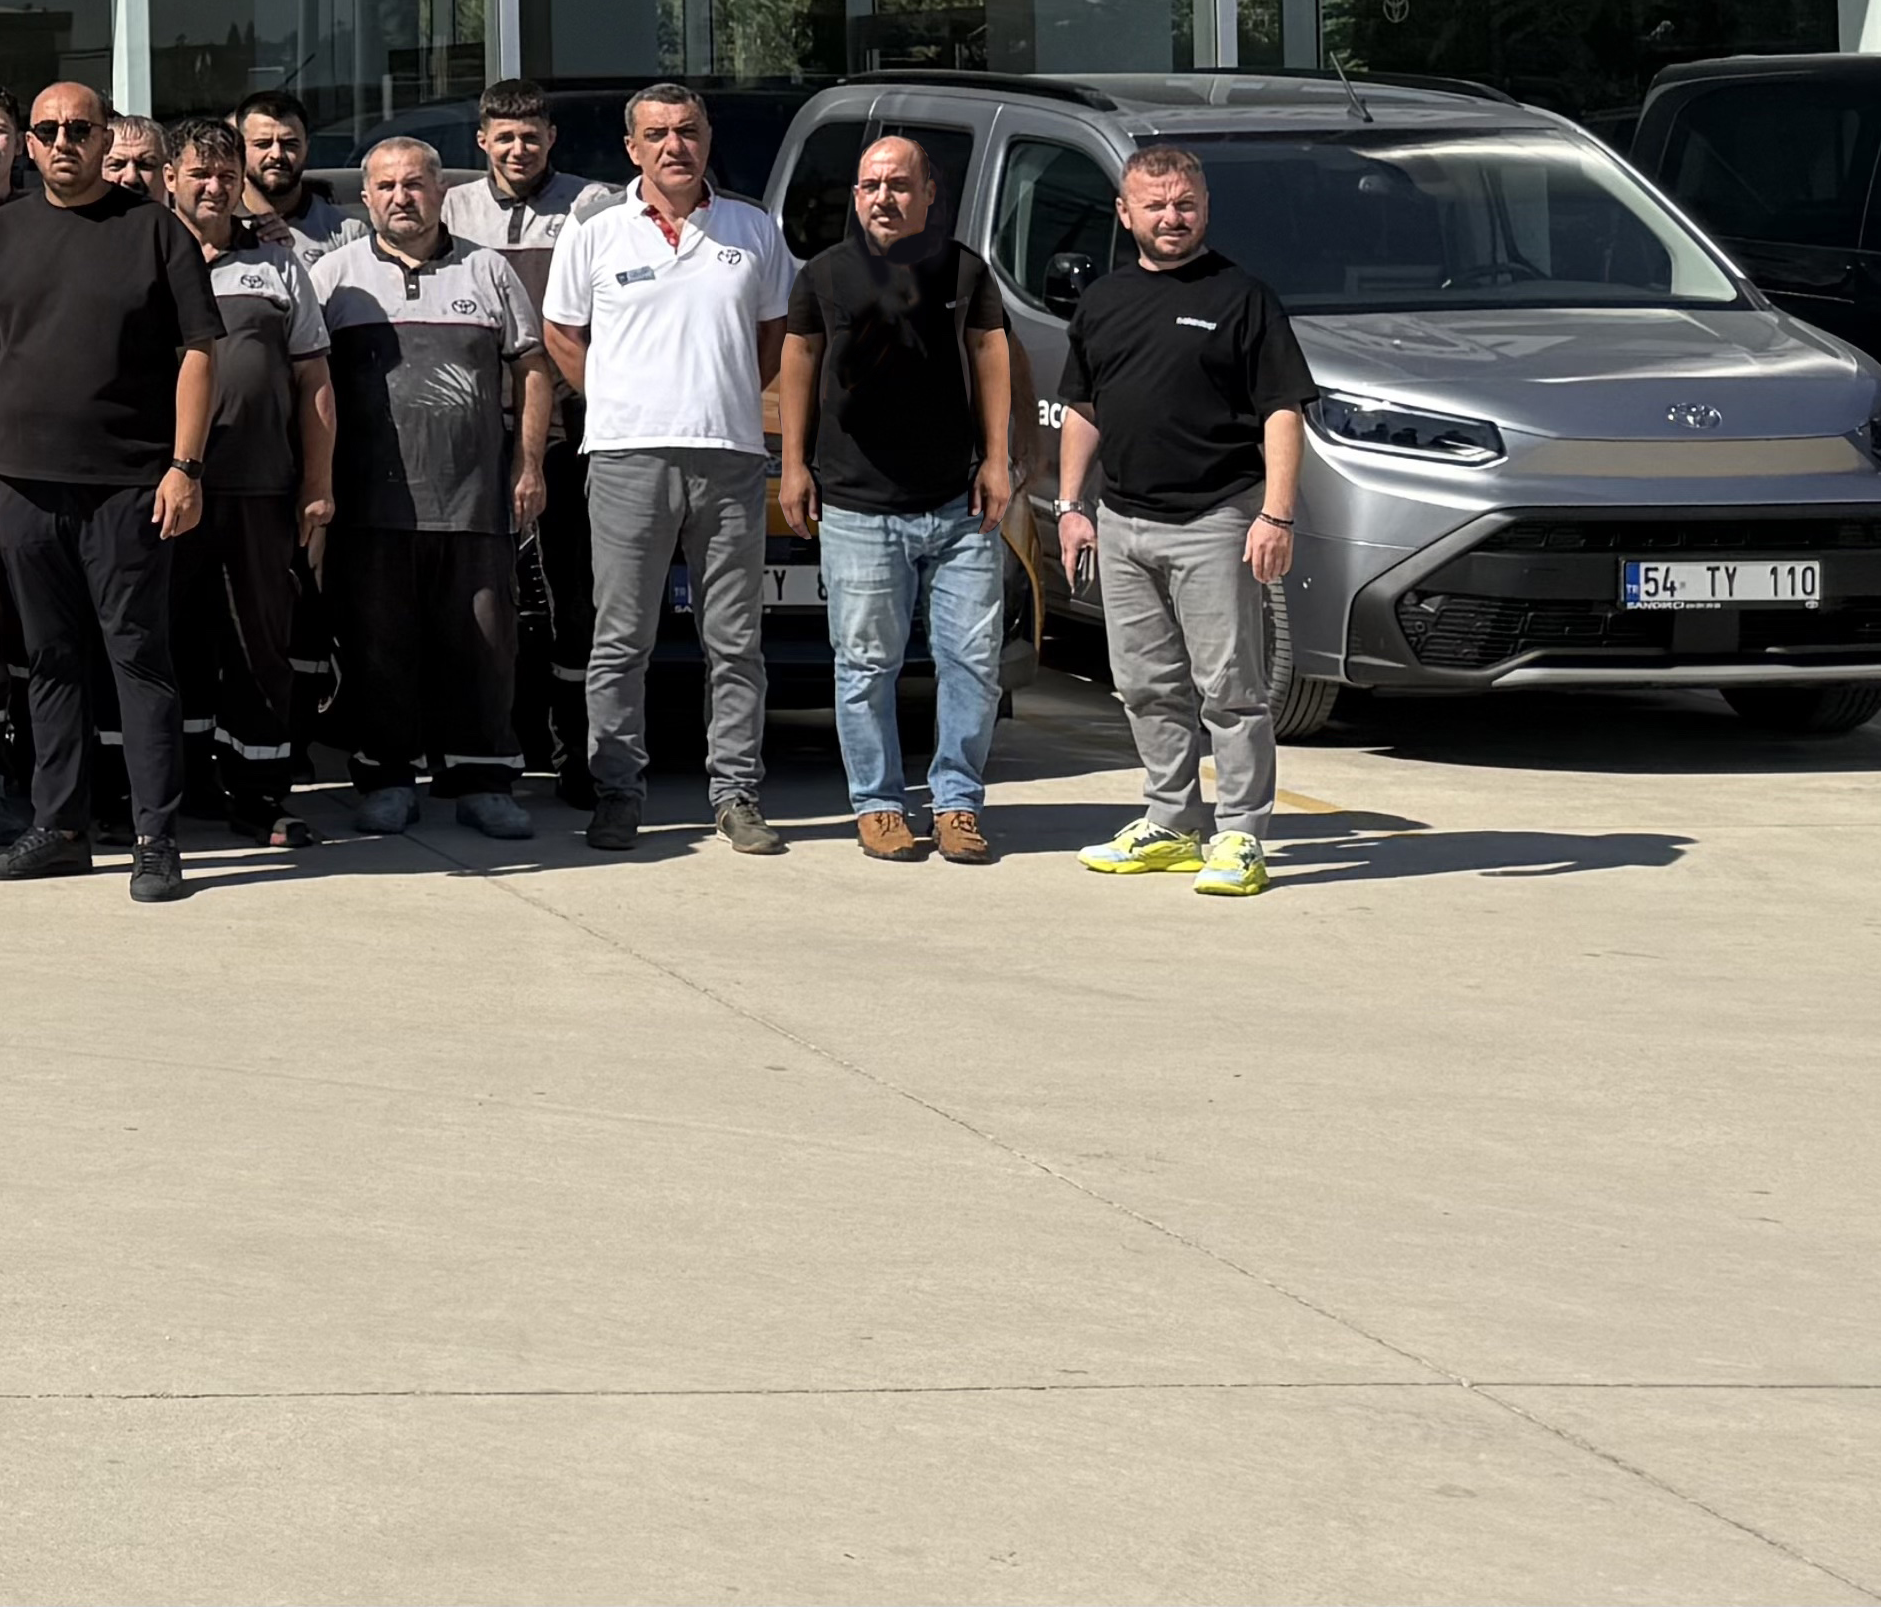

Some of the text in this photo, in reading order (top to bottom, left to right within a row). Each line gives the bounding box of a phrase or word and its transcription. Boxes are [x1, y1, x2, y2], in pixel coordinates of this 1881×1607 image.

[763, 569, 787, 601] Y
[1644, 566, 1678, 598] 54
[1706, 566, 1737, 598] TY
[1769, 566, 1816, 598] 110
